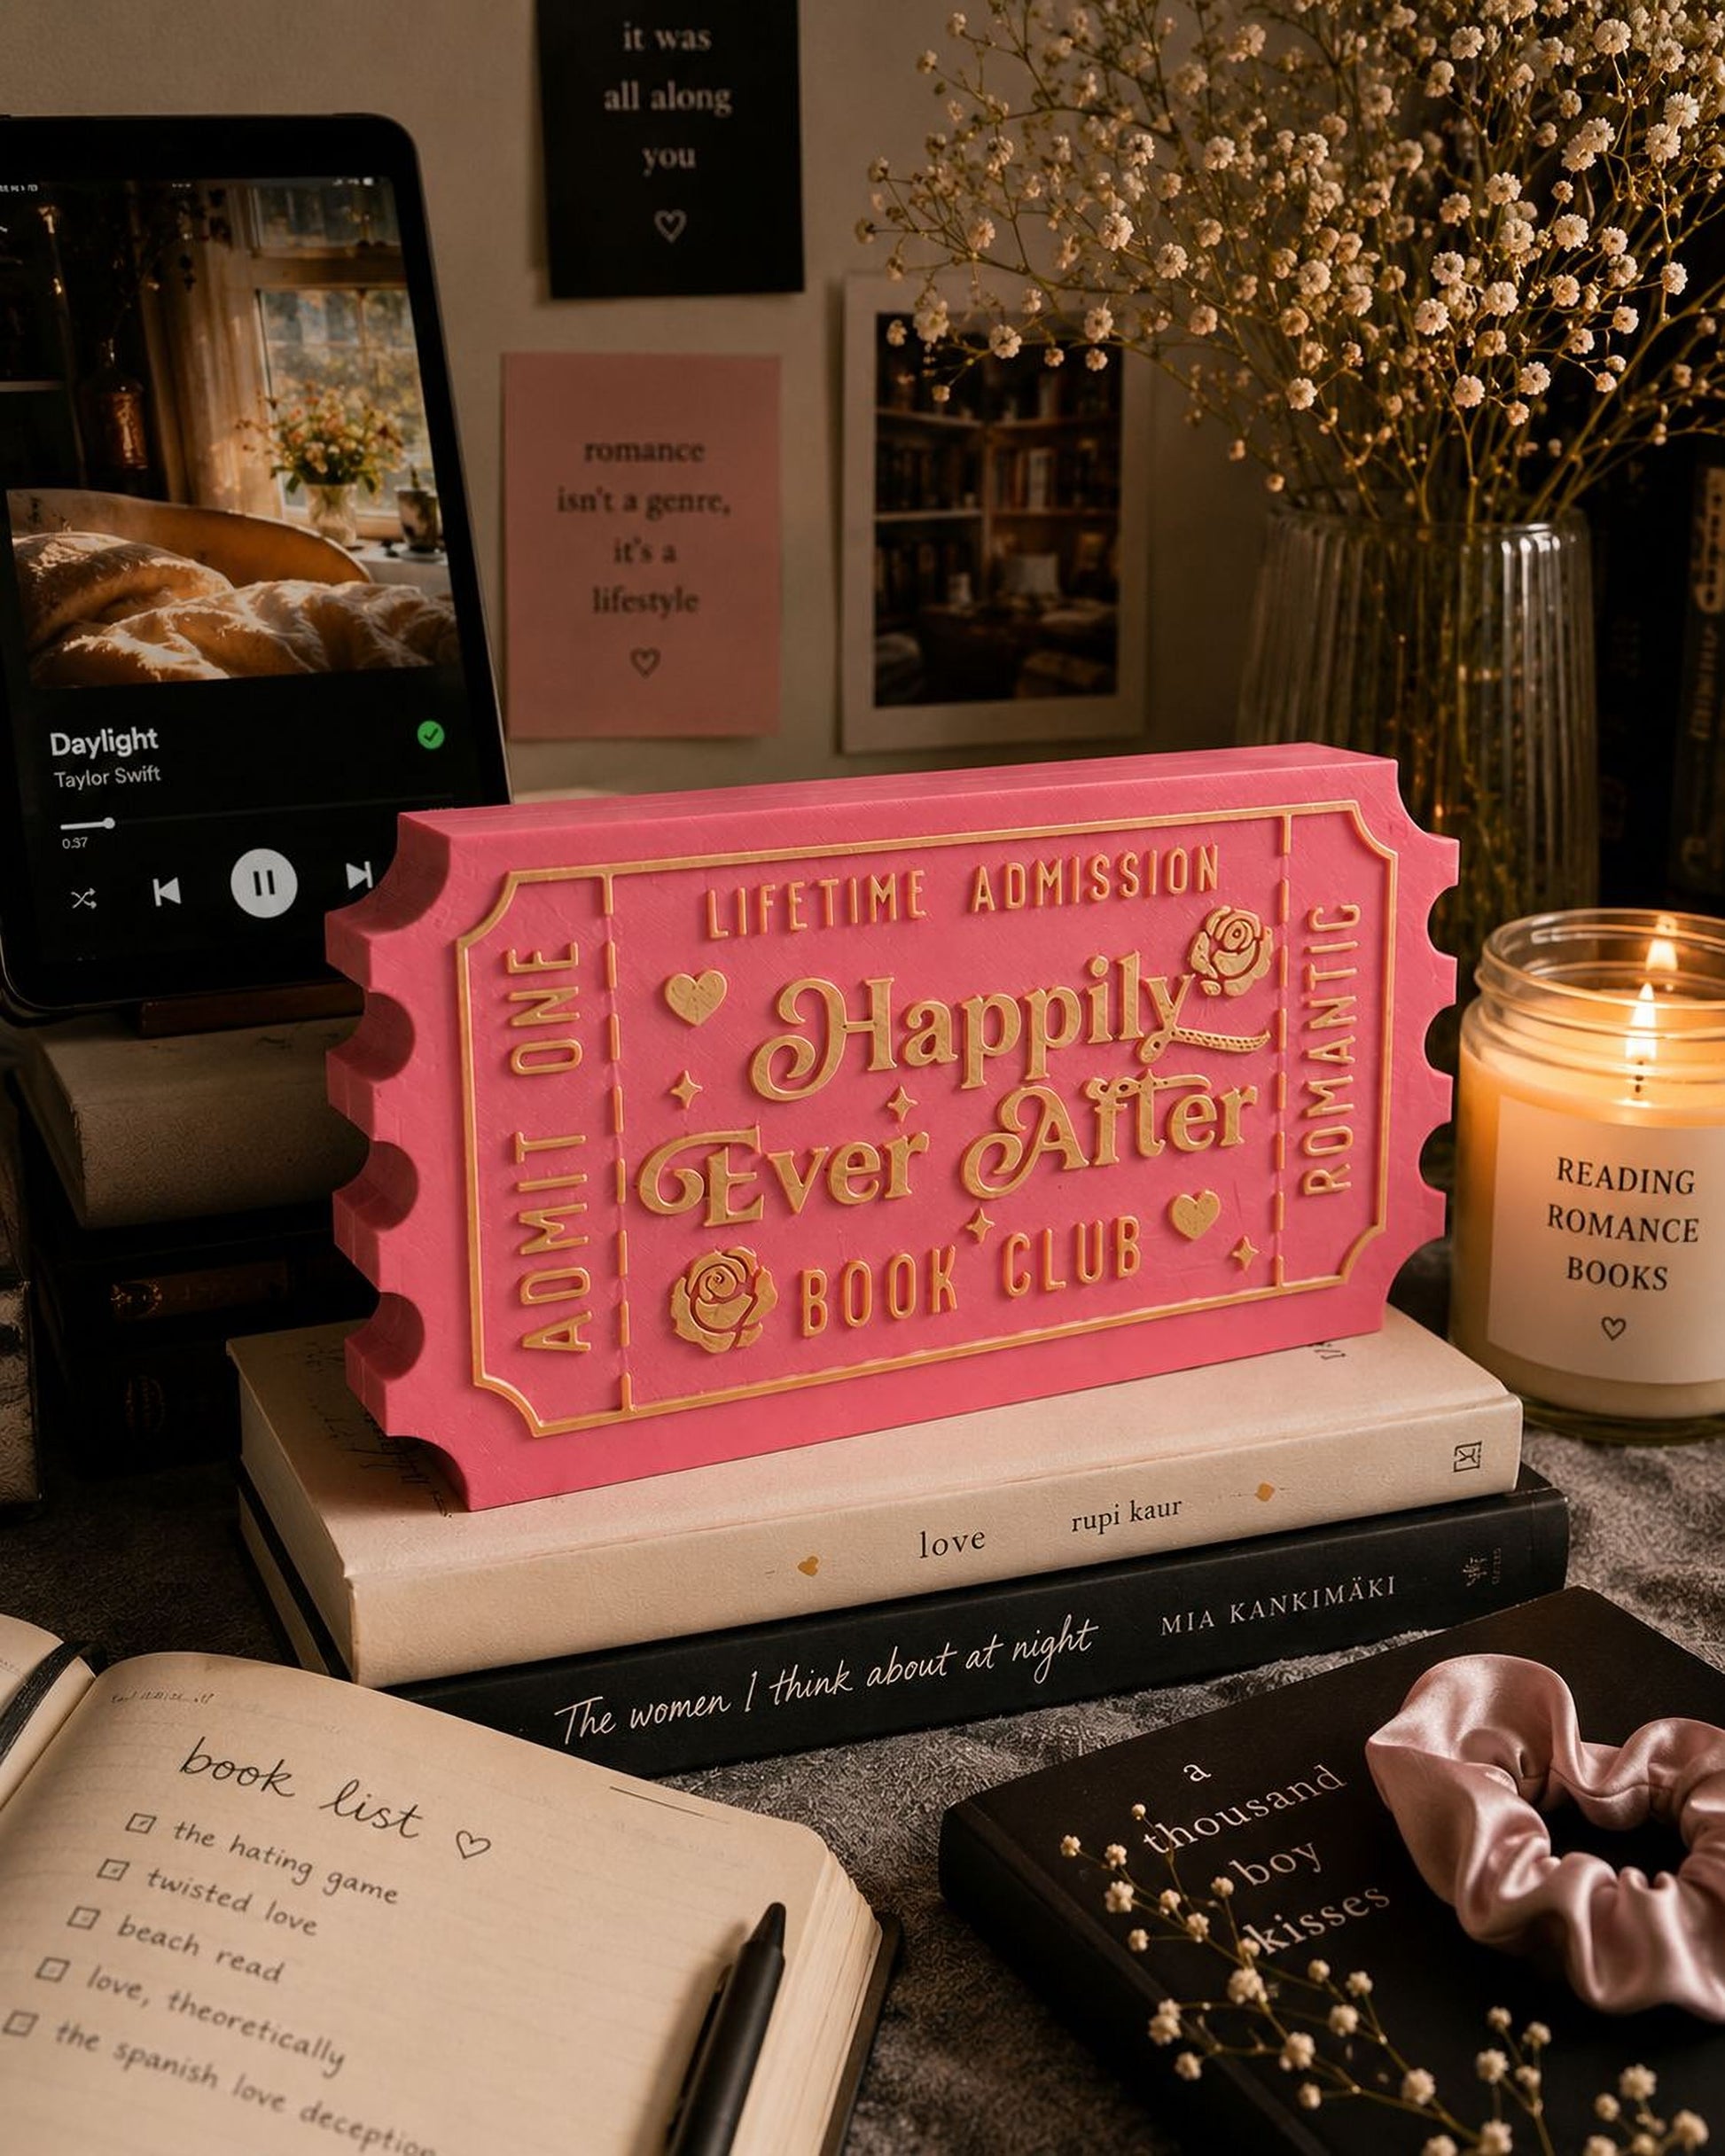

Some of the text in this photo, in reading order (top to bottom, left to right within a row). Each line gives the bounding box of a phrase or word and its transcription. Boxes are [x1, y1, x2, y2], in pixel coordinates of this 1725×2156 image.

[622, 21, 712, 51] it was
[604, 81, 734, 118] all along
[642, 147, 697, 176] you
[583, 442, 706, 463] romance
[557, 487, 732, 521] isn't a genre,
[614, 537, 677, 564] it's a
[593, 585, 700, 621] lifestyle
[50, 726, 160, 760] Daylight
[54, 765, 161, 791] Taylor Swift
[707, 844, 1221, 940] LIFETIME ADMISSION
[750, 949, 1273, 1103] Happily
[1303, 902, 1362, 1196] ROMANTIC
[505, 941, 592, 1354] ADMIT ONE
[636, 1066, 1261, 1229] Ever After
[1557, 1156, 1696, 1195] READING
[1547, 1203, 1700, 1243] ROMANCE
[800, 1215, 1142, 1339] BOOK CLUB
[1566, 1255, 1668, 1291] BOOKS
[918, 1498, 1183, 1560] love rupi kaur
[554, 1574, 1396, 1746] The women I think about at night MIA KANKIMÄKI
[179, 1736, 425, 1839] book list
[1183, 1763, 1211, 1782] a
[1143, 1764, 1347, 1855] thousand
[172, 1820, 399, 1906] the hating game
[1229, 1841, 1322, 1886] boy
[147, 1867, 318, 1936] twisted love
[1242, 1887, 1391, 1956] kisses
[117, 1914, 285, 1984] beach read
[86, 1965, 347, 2080] love, theoretically
[56, 2020, 100, 2052] the
[113, 2042, 219, 2090] spanish
[231, 2073, 287, 2113] love
